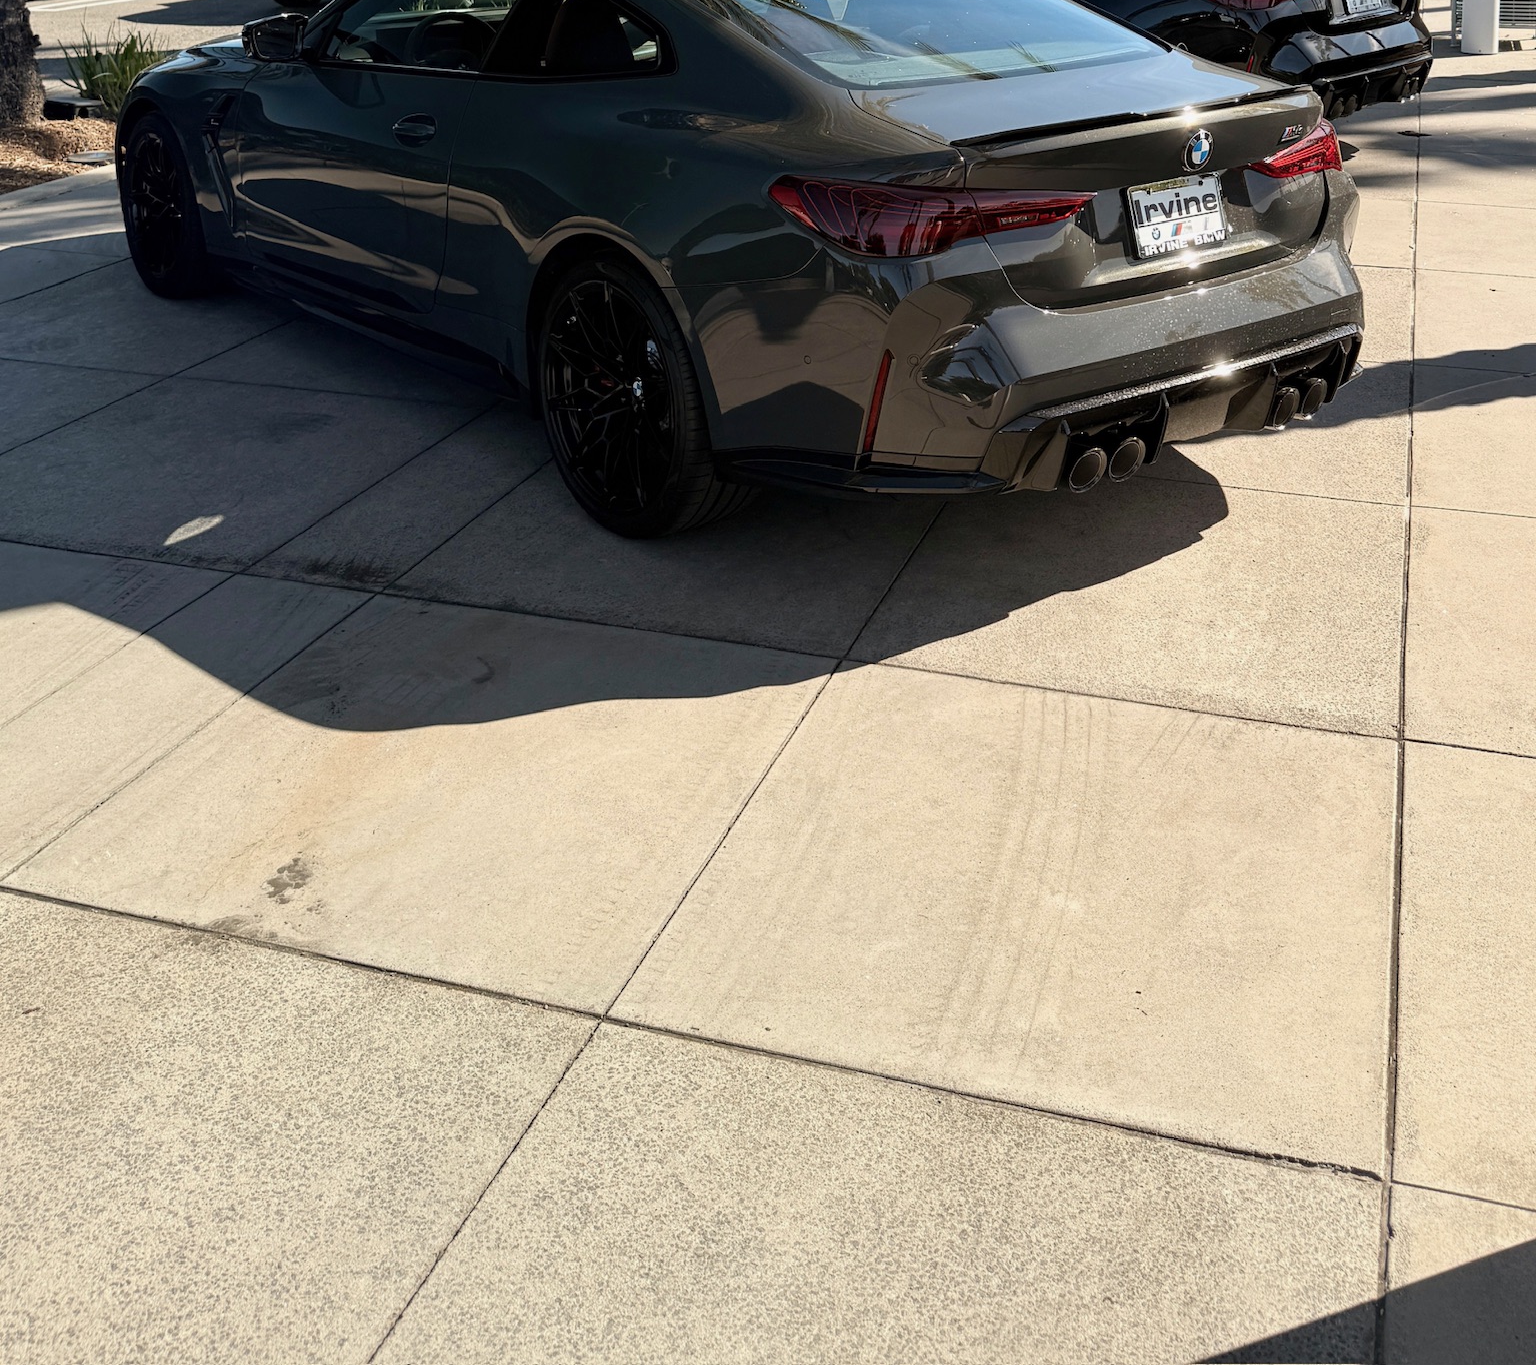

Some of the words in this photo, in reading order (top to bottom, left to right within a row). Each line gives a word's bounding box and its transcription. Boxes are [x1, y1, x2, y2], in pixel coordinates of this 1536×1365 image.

[1134, 192, 1219, 225] Irvine
[1143, 239, 1188, 257] IRVINE
[1194, 229, 1227, 246] BMW
